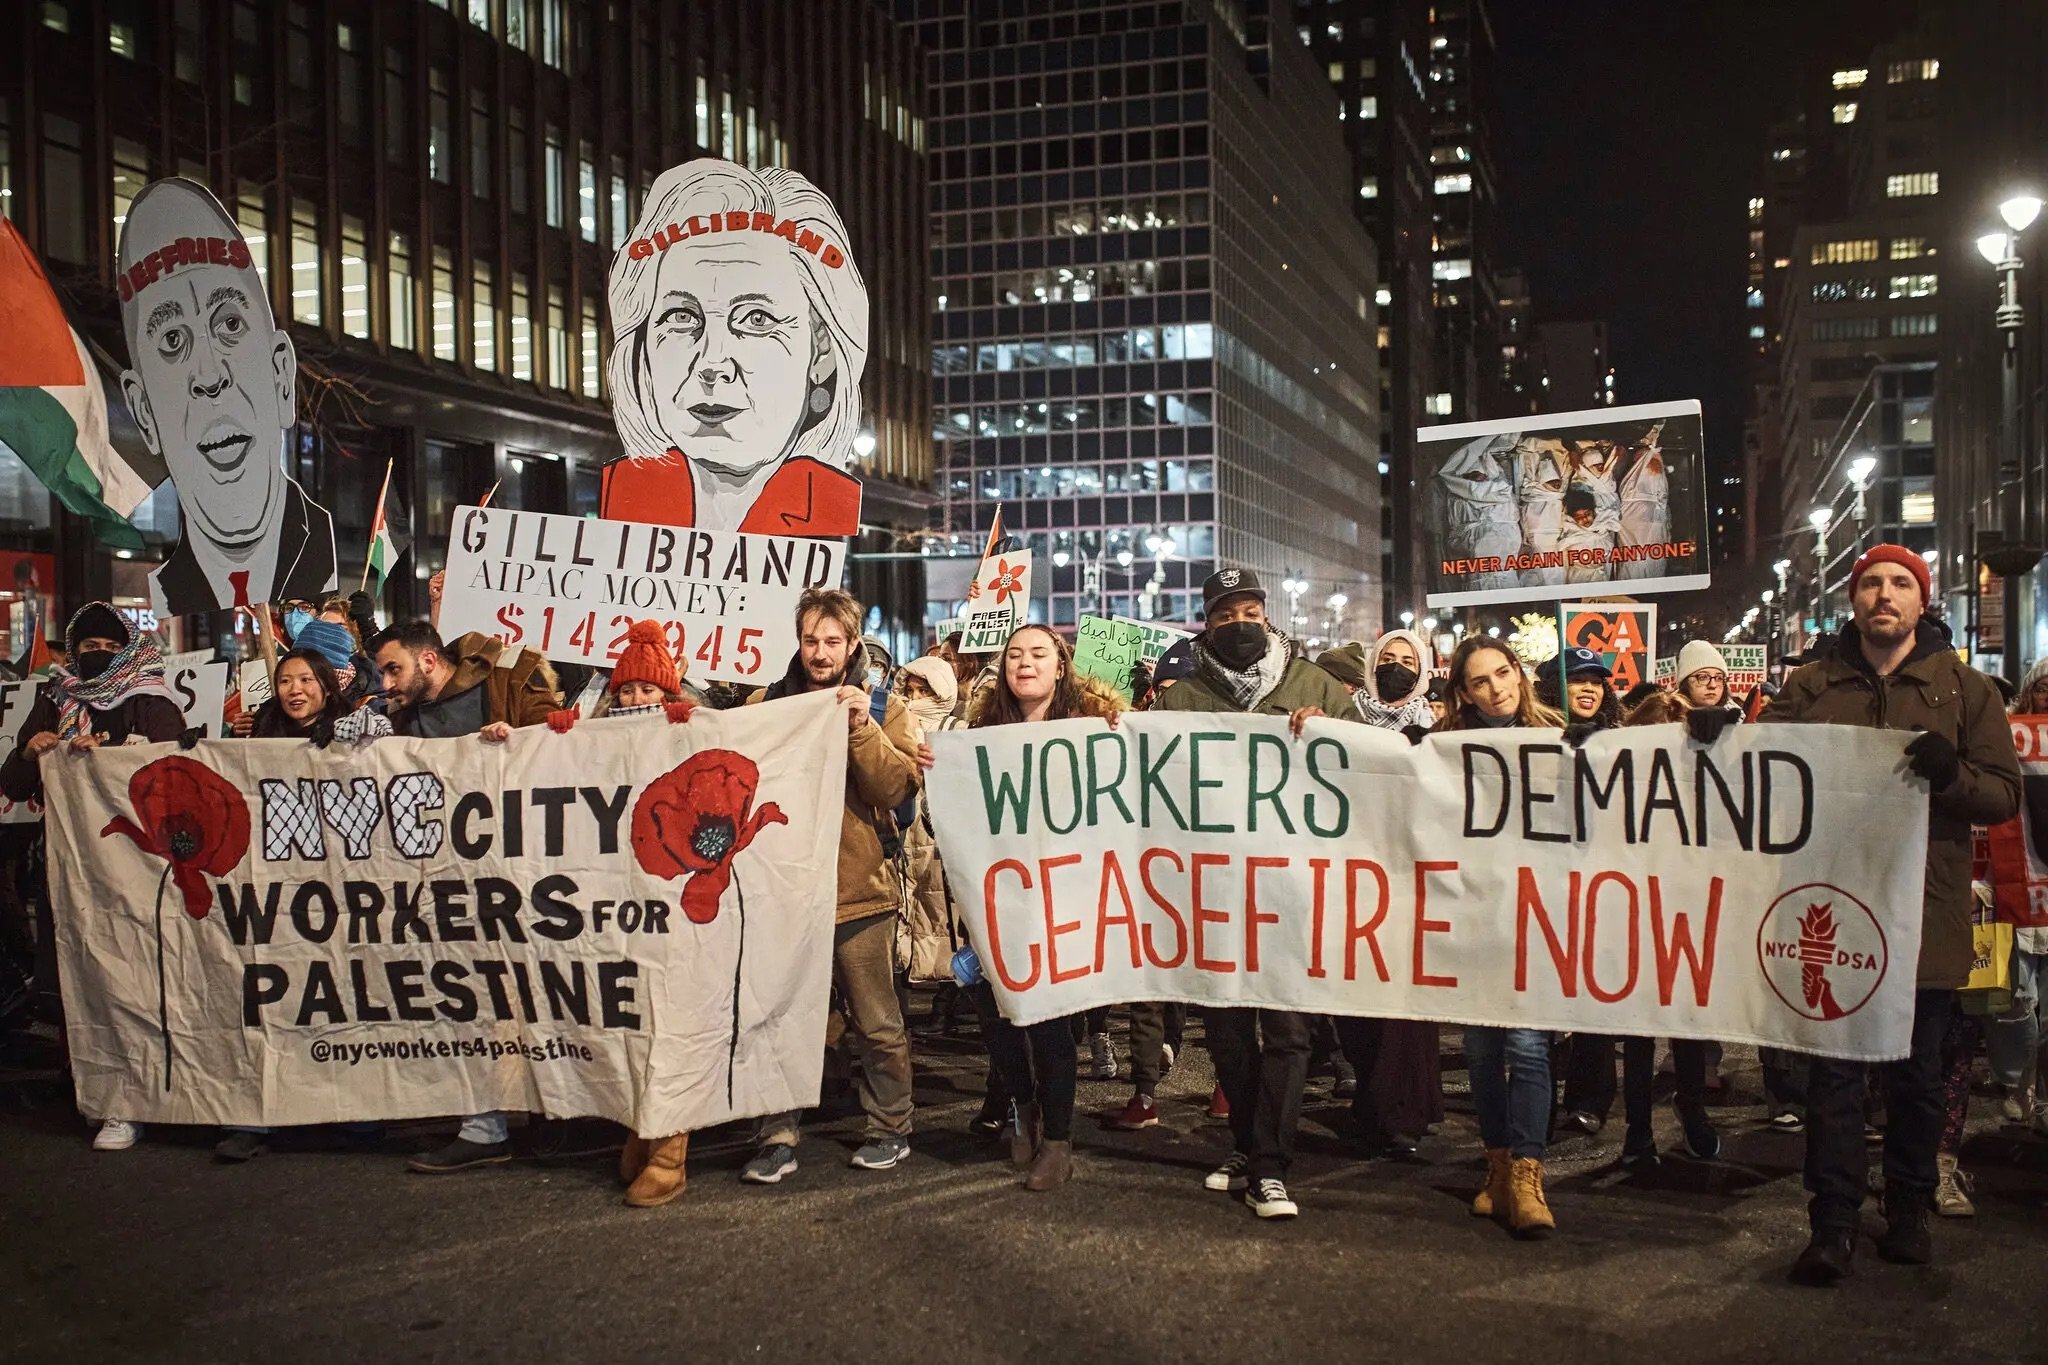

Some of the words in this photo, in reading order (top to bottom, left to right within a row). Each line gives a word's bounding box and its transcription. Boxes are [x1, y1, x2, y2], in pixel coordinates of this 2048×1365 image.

[118, 237, 250, 302] JEFFRIES
[628, 211, 844, 269] GILLIBRAND
[462, 509, 832, 589] GILLIBRAND
[1442, 555, 1500, 576] NEVER
[1505, 550, 1564, 572] AGAIN
[1568, 547, 1607, 568] FOR
[1609, 541, 1691, 563] ANYONE
[468, 559, 584, 600] AIPAC
[600, 572, 746, 616] MONEY:
[972, 609, 1011, 621] FREE
[1735, 647, 1764, 658] THE
[260, 772, 445, 861] NYC
[451, 785, 633, 860] CITY
[976, 732, 1350, 838] WORKERS
[1462, 743, 1813, 854] DEMAND
[216, 874, 584, 946] WORKERS
[592, 900, 670, 934] FOR
[984, 847, 1458, 992] CEASEFIRE
[1515, 867, 1723, 1007] NOW
[1766, 941, 1797, 958] NYC
[1837, 951, 1877, 971] DSA
[243, 960, 641, 1030] PALESTINE
[311, 1037, 593, 1064] @nycworkers4palestine
